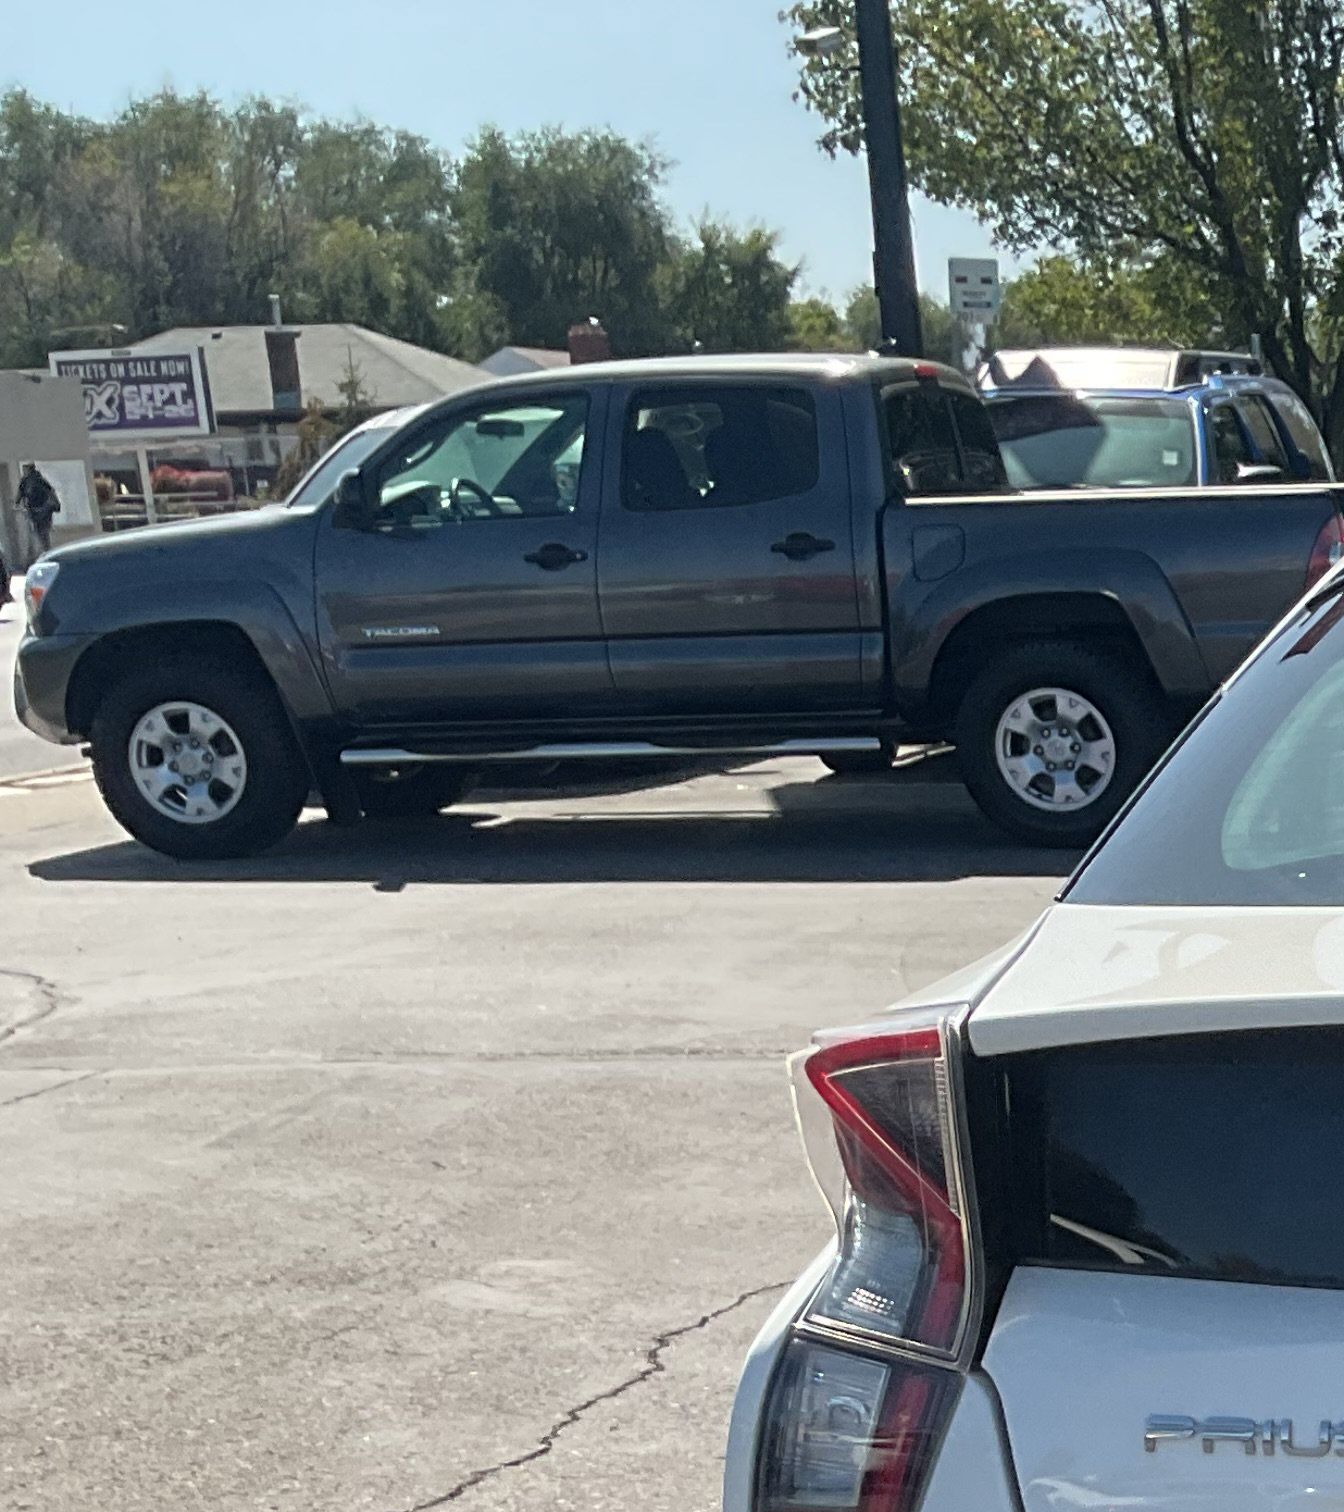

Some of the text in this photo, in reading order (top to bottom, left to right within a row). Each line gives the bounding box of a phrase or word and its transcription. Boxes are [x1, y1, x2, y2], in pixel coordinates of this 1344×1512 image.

[60, 362, 107, 379] TICKETS
[110, 362, 125, 378] ON
[129, 360, 157, 377] SALE
